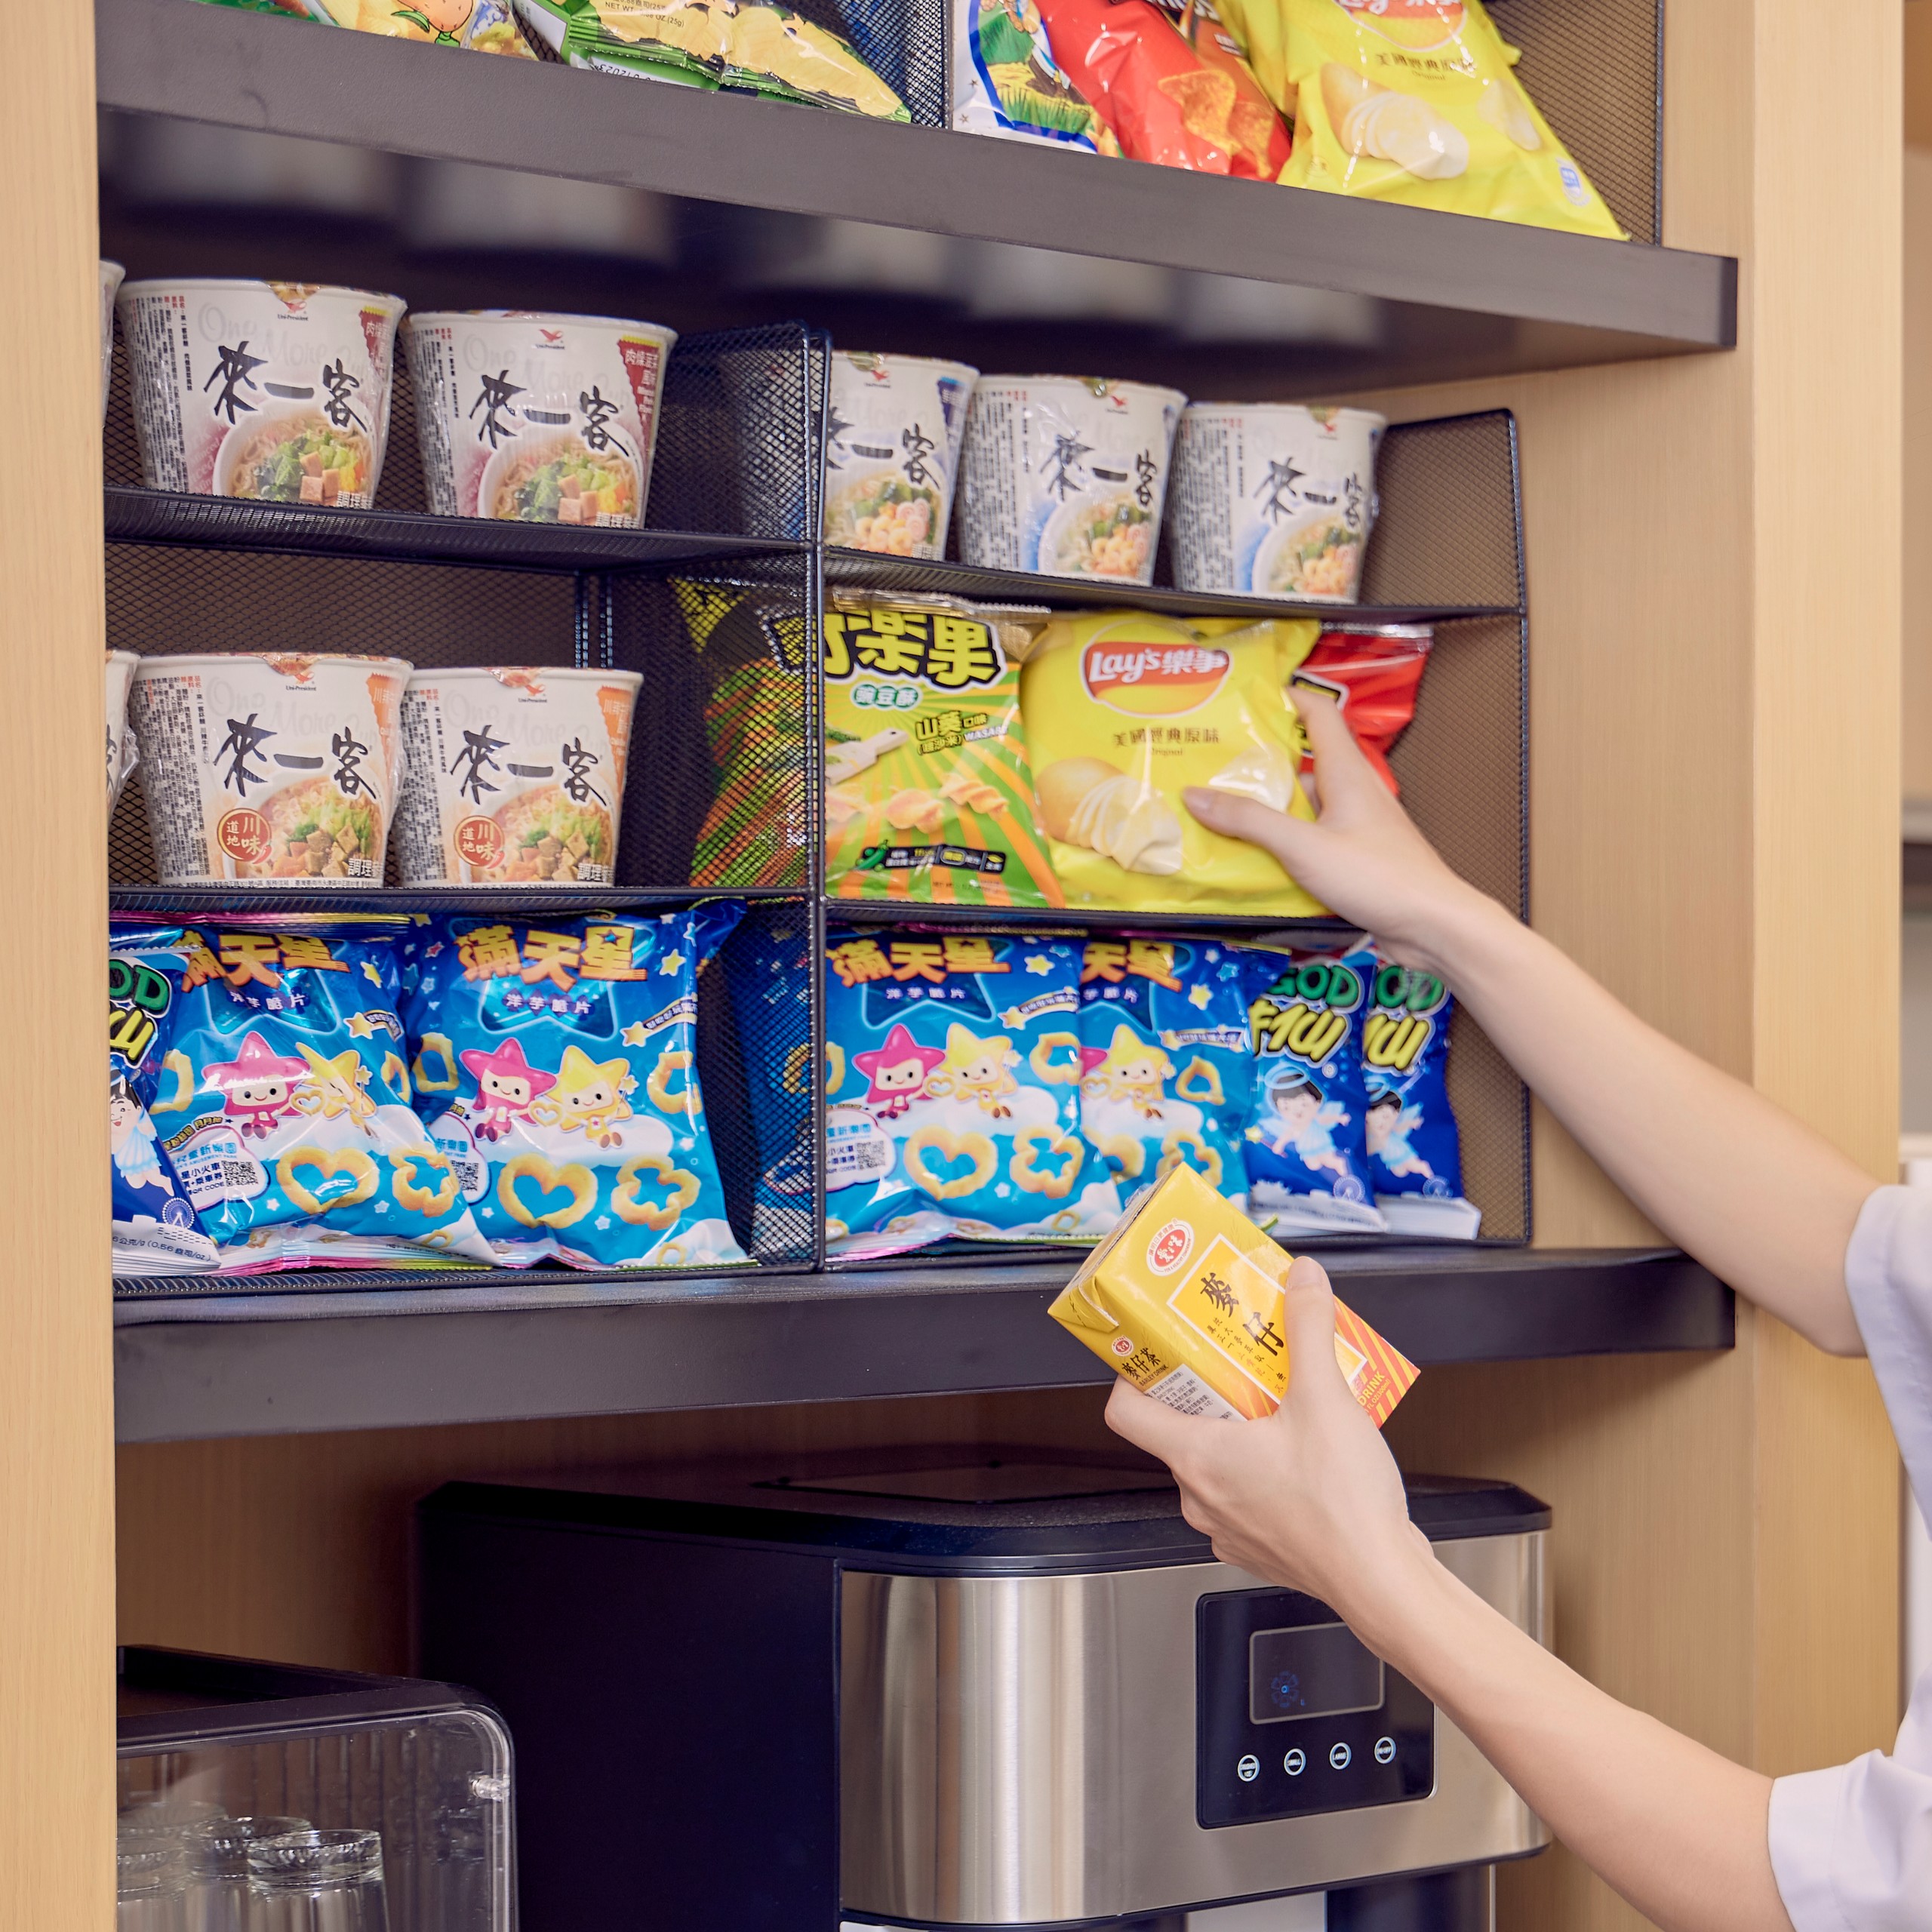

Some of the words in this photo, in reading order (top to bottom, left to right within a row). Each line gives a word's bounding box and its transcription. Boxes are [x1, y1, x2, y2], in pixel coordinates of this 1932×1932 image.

[203, 341, 368, 432] 來一客
[469, 370, 629, 457] 來一客
[1039, 431, 1158, 507] 來一客
[1253, 457, 1362, 528] 來一客
[1088, 648, 1161, 683] Lay's
[213, 713, 377, 799] 來一客
[1113, 727, 1220, 747] 美國經典原味
[450, 724, 607, 806] 來一客
[454, 924, 648, 992] 滿天星
[824, 936, 1011, 988] 滿天星
[1079, 940, 1183, 992] 天星
[505, 993, 592, 1014] 洋芋脆片
[205, 1181, 225, 1191] CODE
[1121, 1347, 1161, 1380] 麥仔茶
[1139, 1375, 1155, 1387] BARLEY
[1153, 1364, 1170, 1380] DRINK
[1357, 1371, 1385, 1406] DRINK
